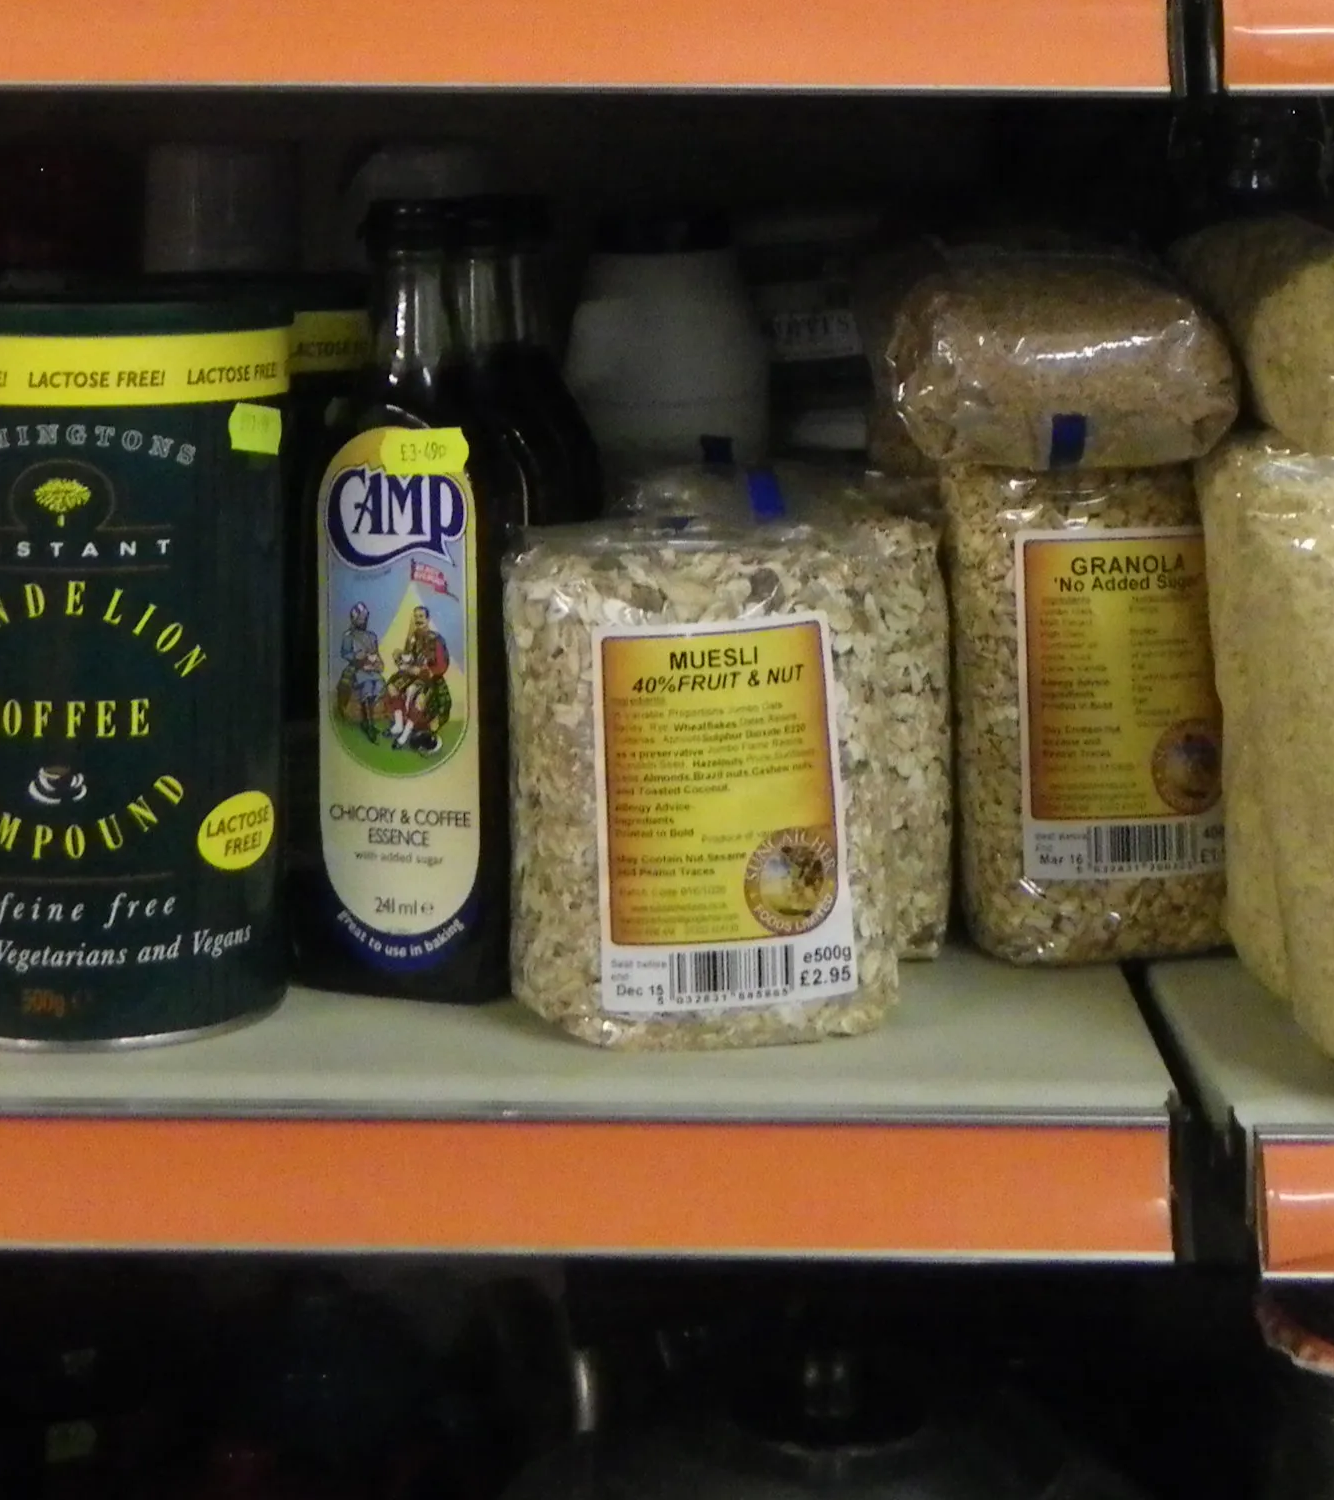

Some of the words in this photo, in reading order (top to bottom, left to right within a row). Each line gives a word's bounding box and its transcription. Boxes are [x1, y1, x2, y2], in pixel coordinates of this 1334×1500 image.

[28, 370, 110, 389] LACTOSE
[116, 369, 166, 388] FREE!
[186, 366, 251, 386] LACTOSE
[327, 465, 466, 570] CAMP
[1070, 553, 1186, 577] GRANOLA
[1091, 573, 1150, 592] Added
[669, 647, 759, 671] MUESLI
[747, 672, 760, 687] &
[766, 664, 805, 685] NUT
[674, 720, 738, 733] Wheatflakes
[643, 772, 690, 784] Almonds
[205, 803, 271, 838] LACTOSE
[329, 803, 396, 825] CHICORY
[400, 809, 411, 825] &
[414, 809, 471, 829] COFFEE
[223, 830, 263, 858] FREE!
[368, 827, 430, 848] ESSENCE
[103, 891, 177, 930] free
[137, 934, 182, 964] and
[193, 924, 252, 958] Vegans
[799, 965, 852, 988] £2.95
[616, 984, 643, 997] Dec
